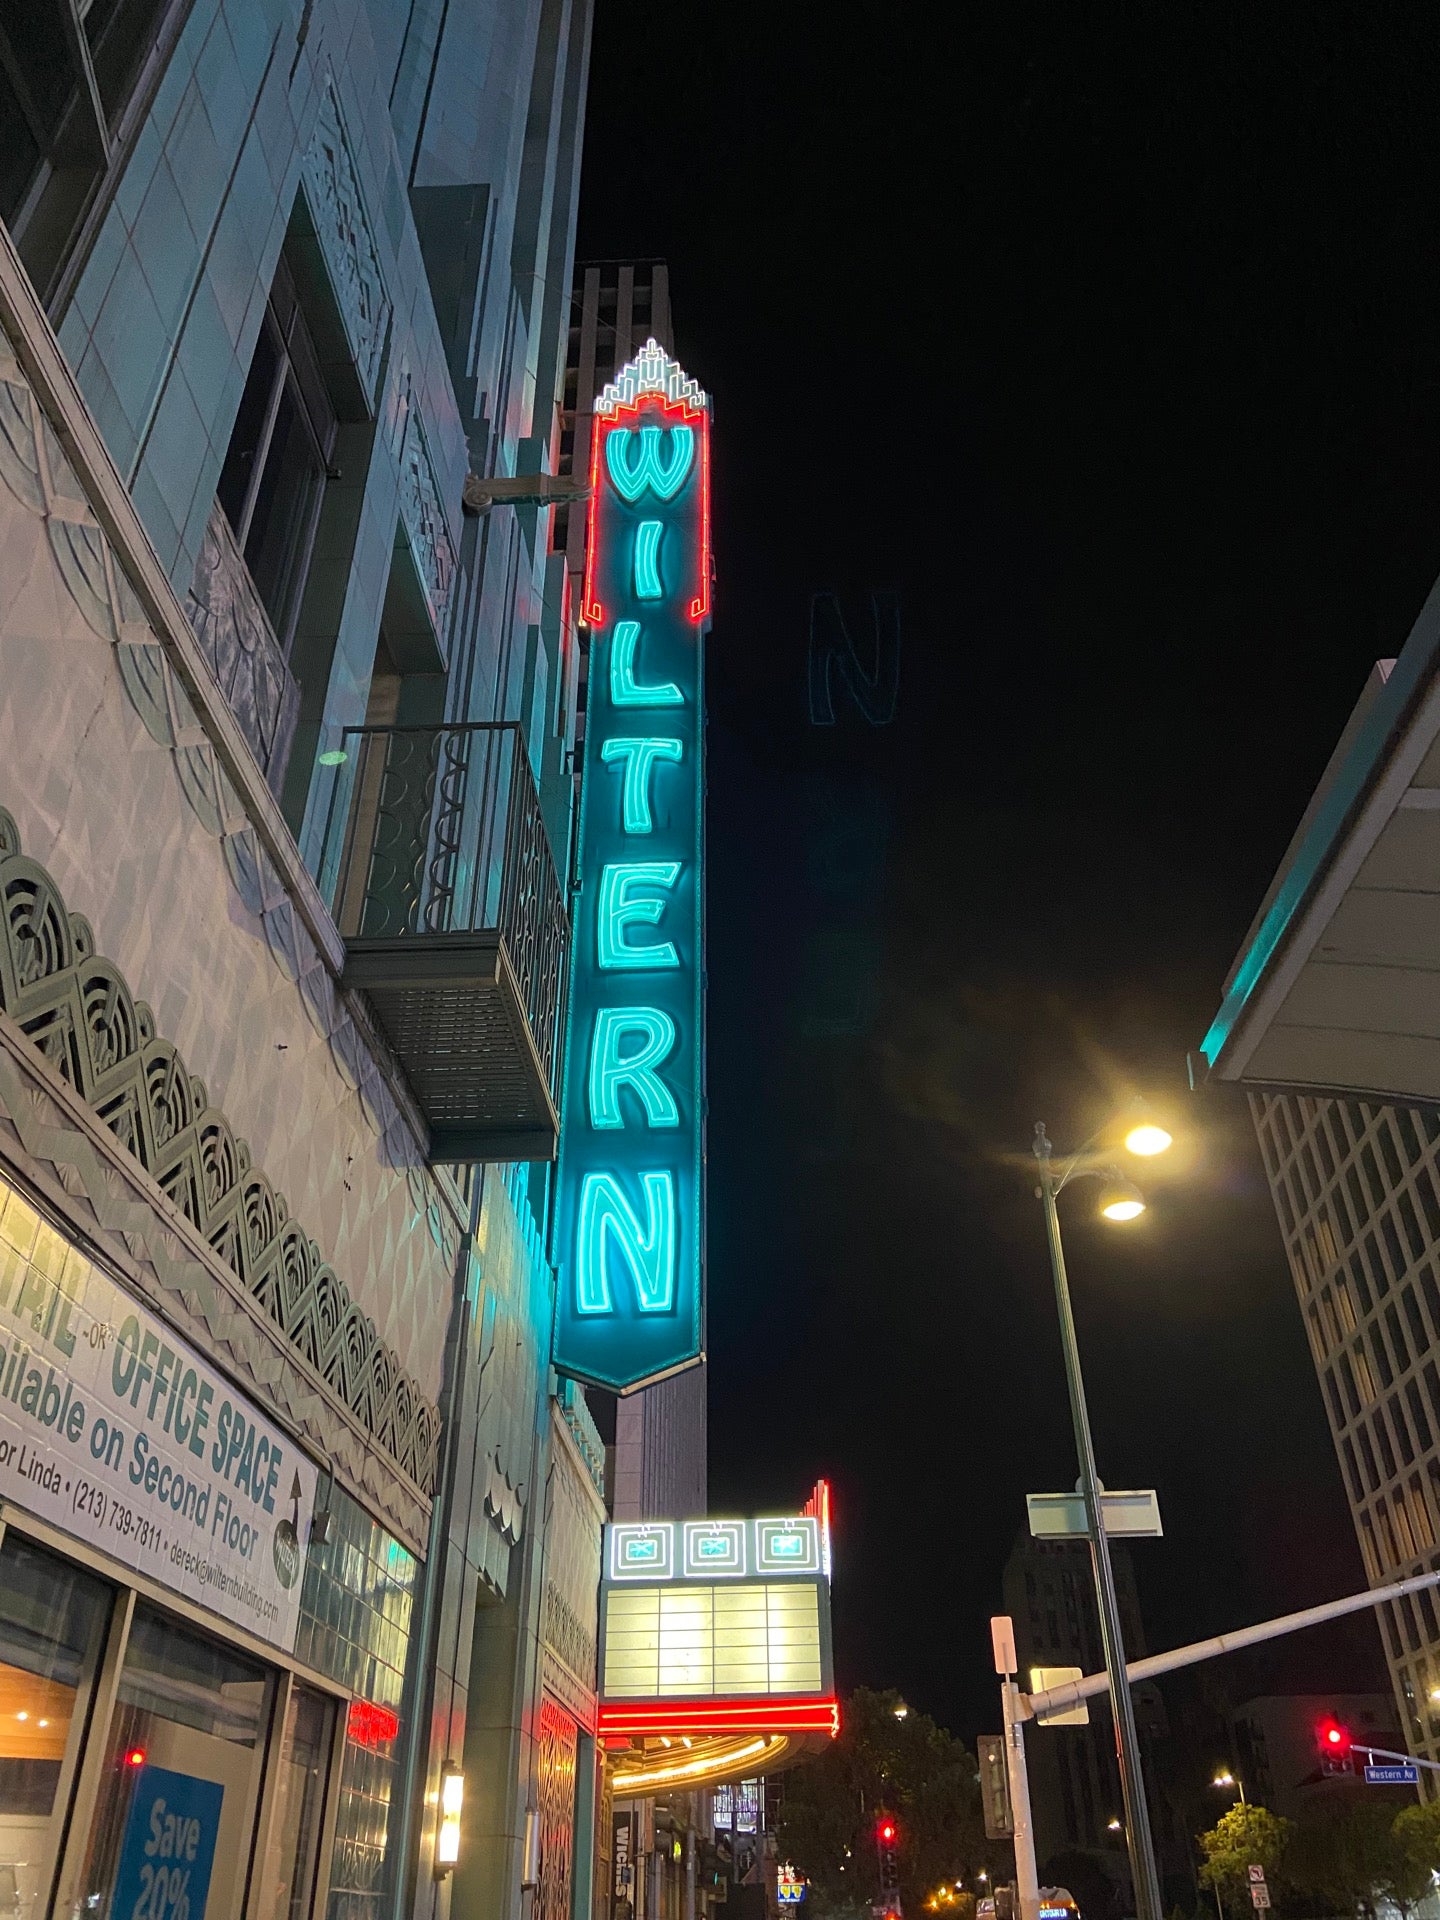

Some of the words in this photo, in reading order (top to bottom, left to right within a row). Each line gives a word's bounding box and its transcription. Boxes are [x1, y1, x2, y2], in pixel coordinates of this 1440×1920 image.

[577, 426, 694, 1313] WILTERN
[112, 1315, 214, 1458] OFFICE
[212, 1400, 282, 1515] SPACE
[17, 1445, 61, 1495] Linda
[72, 1479, 107, 1528] (213)
[109, 1501, 161, 1553] 739-7811
[90, 1418, 124, 1471] on
[129, 1432, 211, 1528] Second
[212, 1491, 259, 1561] Floor
[1368, 1769, 1402, 1779] Western
[145, 1799, 201, 1861] Save
[132, 1862, 191, 1920] 20%
